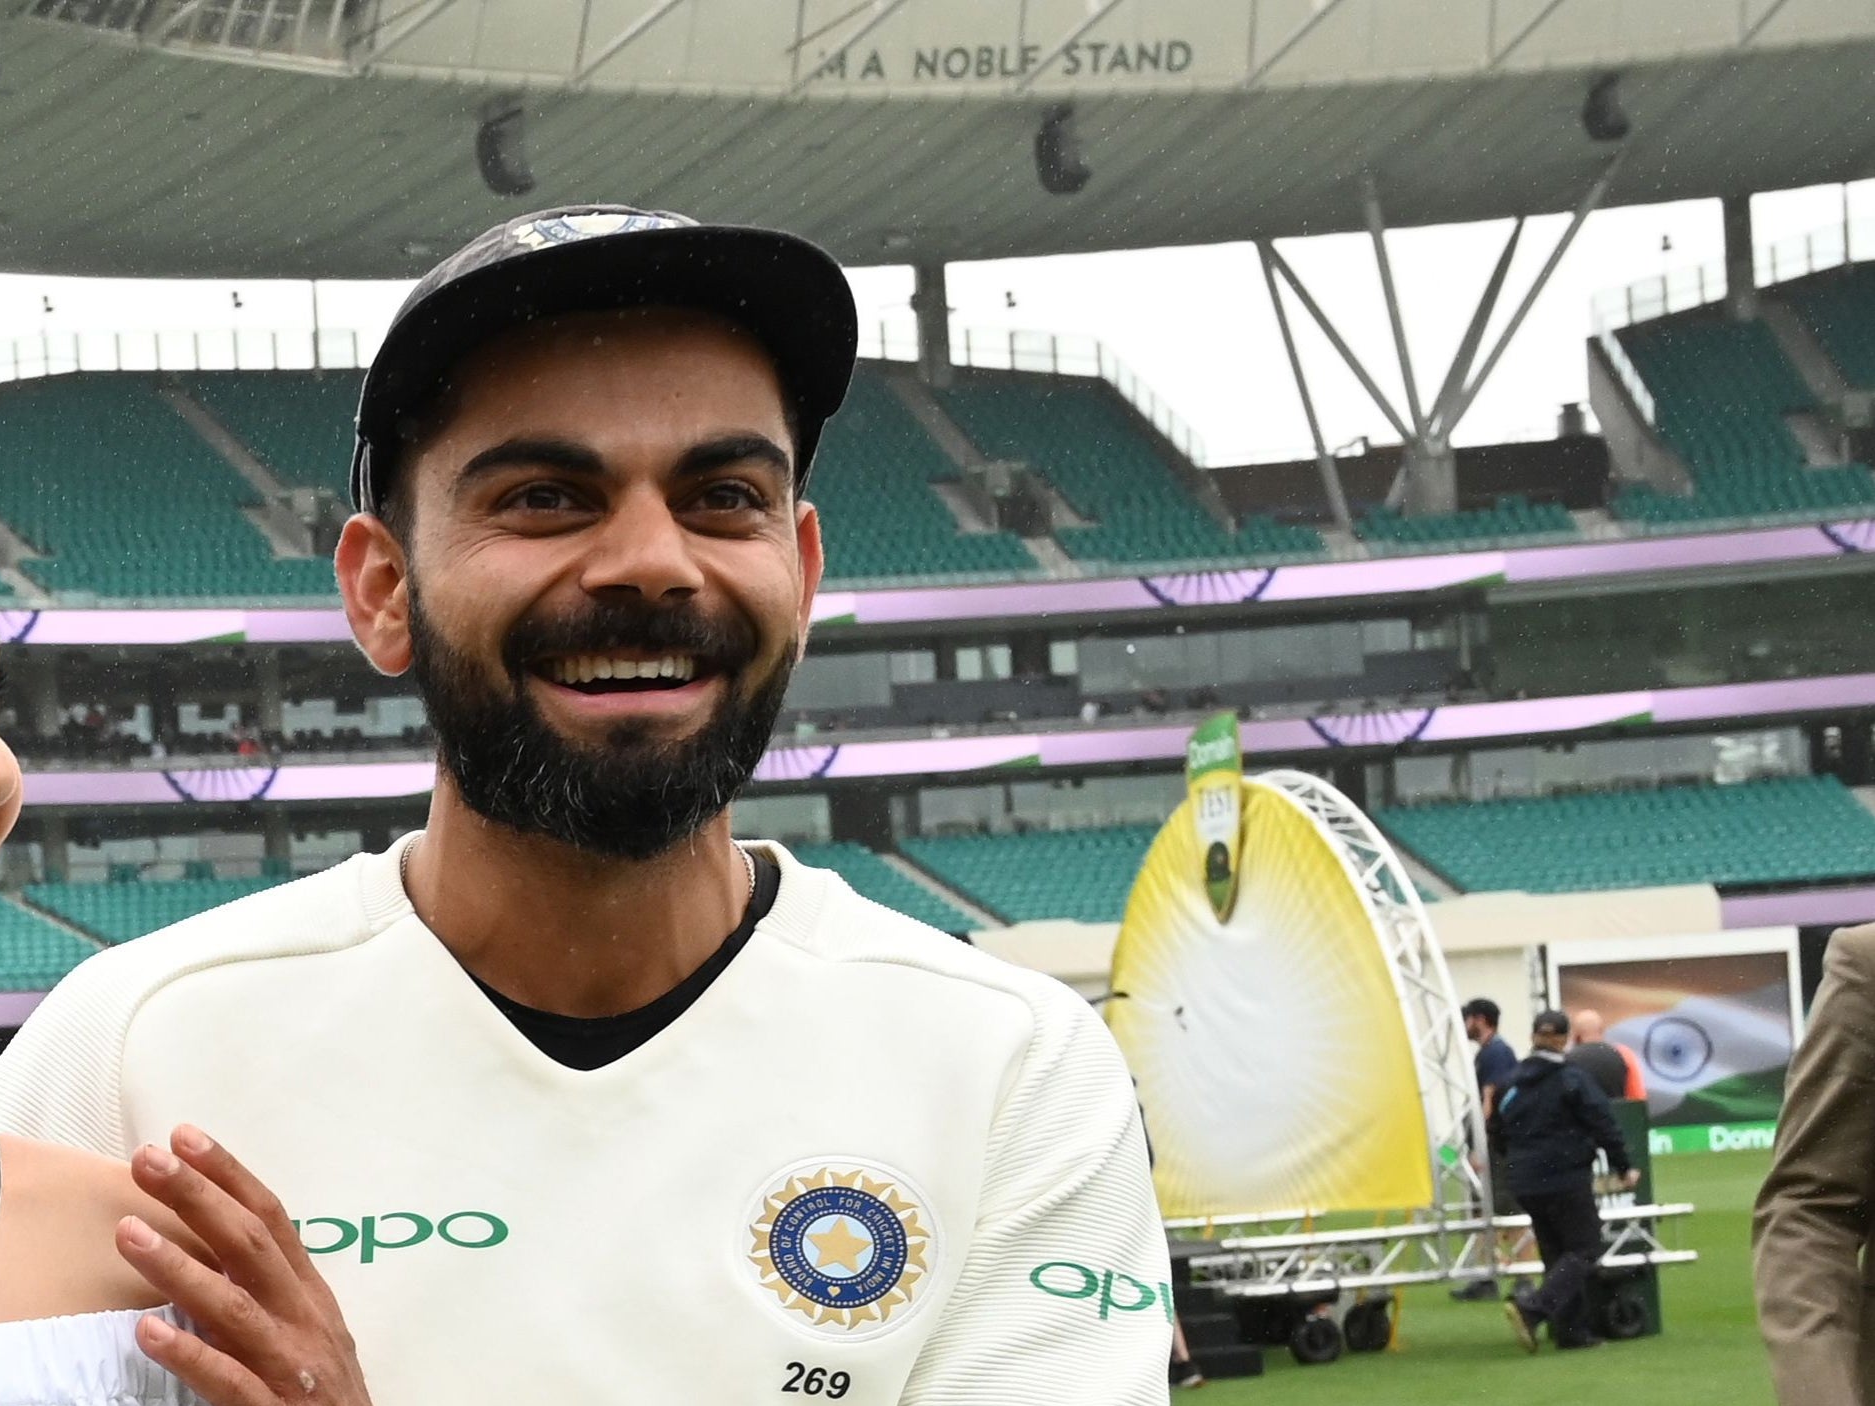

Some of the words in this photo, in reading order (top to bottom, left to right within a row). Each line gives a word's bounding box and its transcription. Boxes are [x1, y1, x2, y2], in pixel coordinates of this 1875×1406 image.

[860, 48, 885, 79] A
[913, 44, 1042, 78] NOBLE
[1061, 40, 1194, 76] STAND
[784, 1197, 832, 1232] CONTROL
[839, 1196, 862, 1210] FOR
[290, 1210, 510, 1264] ppo
[781, 1234, 792, 1249] OF
[866, 1208, 896, 1252] CRICKET
[783, 1253, 814, 1287] BOARD
[881, 1256, 894, 1269] IN
[855, 1271, 888, 1294] INDIA
[781, 1361, 852, 1400] 269
